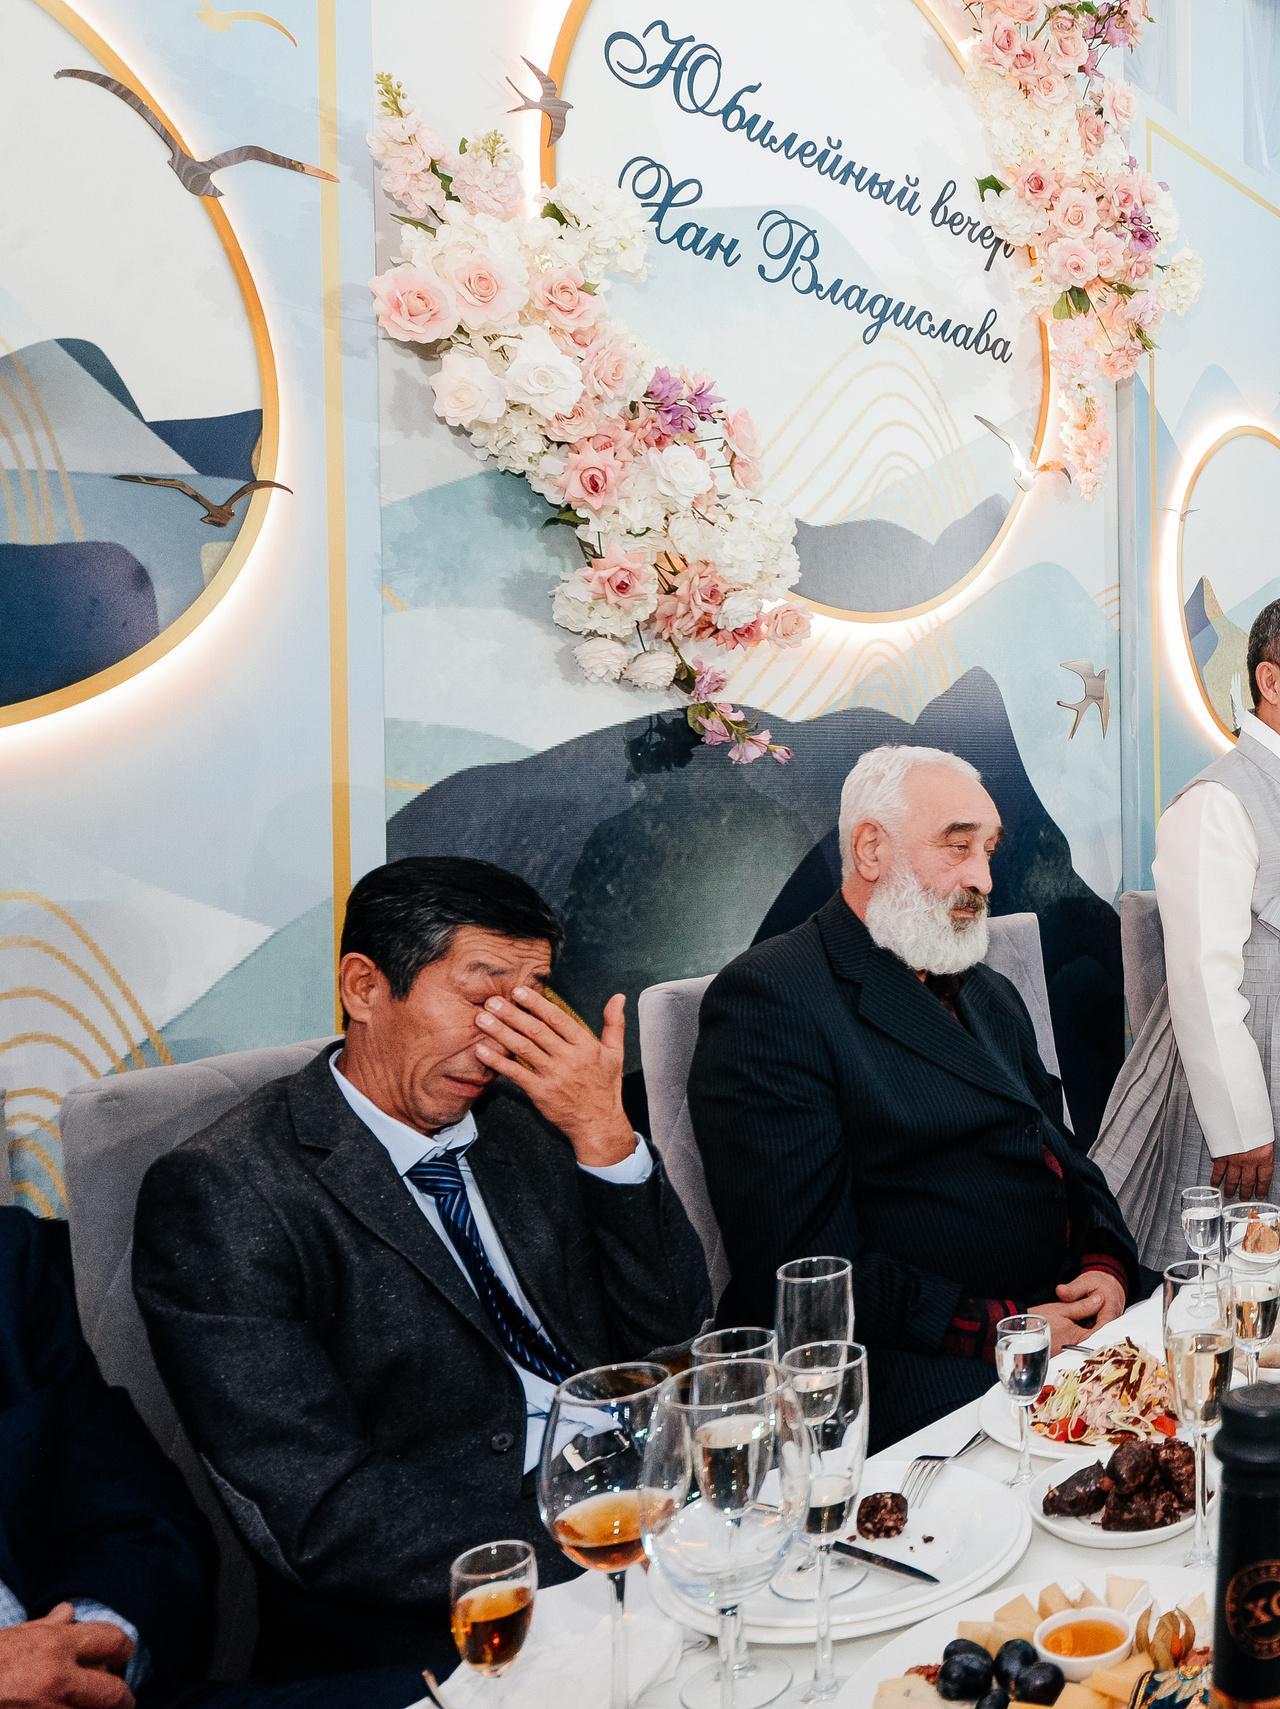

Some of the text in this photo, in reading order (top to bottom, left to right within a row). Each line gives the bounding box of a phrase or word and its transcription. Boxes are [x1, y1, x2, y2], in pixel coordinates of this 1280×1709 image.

[604, 19, 1016, 272] Юбилейный вечер
[617, 155, 1013, 364] Хан Владислава
